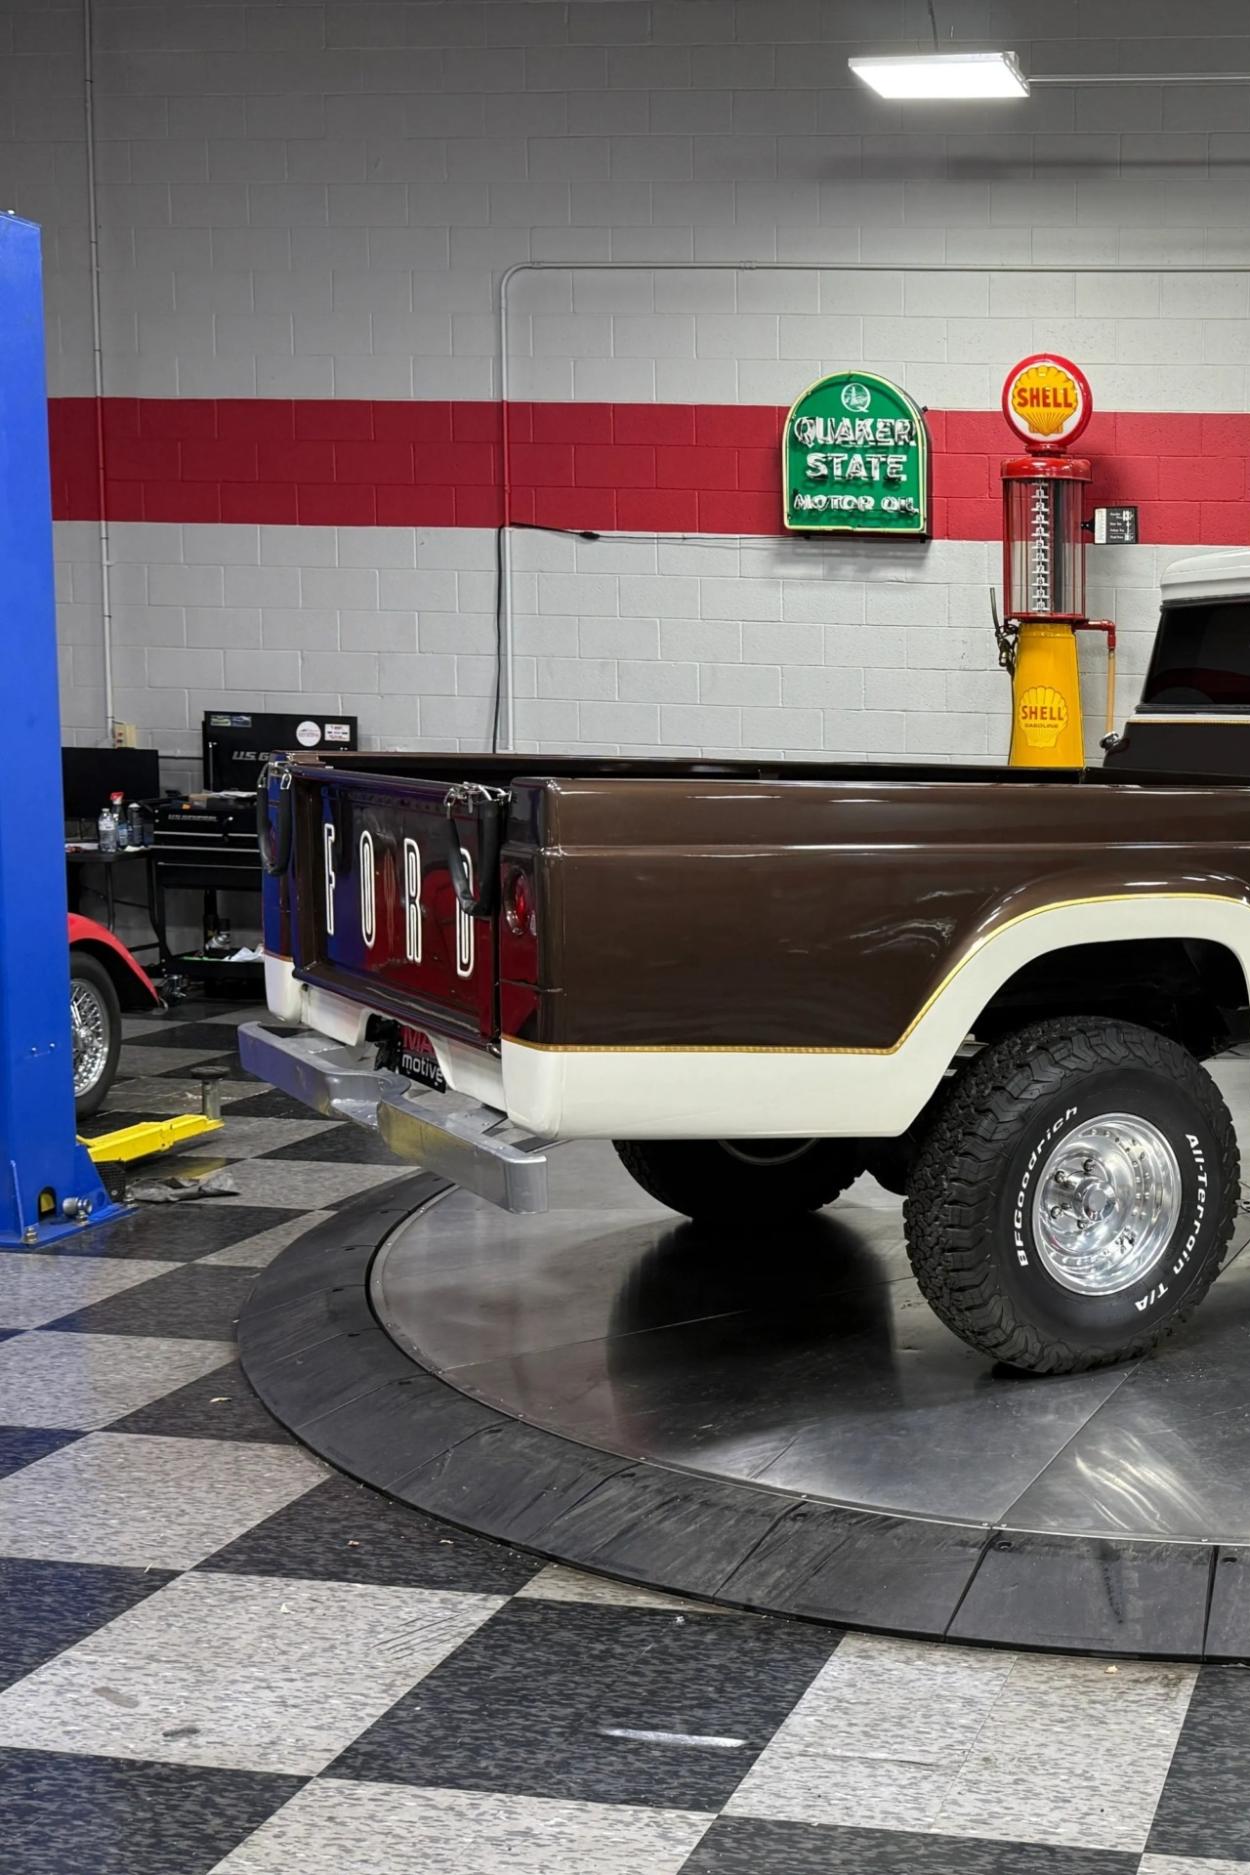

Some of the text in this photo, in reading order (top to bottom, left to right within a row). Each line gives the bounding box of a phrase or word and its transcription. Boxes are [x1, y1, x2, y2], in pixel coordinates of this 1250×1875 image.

[1017, 387, 1073, 408] SHELL
[794, 416, 917, 448] QUAKER
[806, 452, 908, 481] STATE
[793, 494, 875, 511] MOTOR
[1021, 705, 1064, 721] SHELL
[324, 823, 475, 978] FORD
[402, 1026, 436, 1056] MA
[402, 1054, 444, 1084] motive
[1014, 1105, 1079, 1267] BFGoodrich
[1134, 1132, 1209, 1313] All-Terrain T/A
